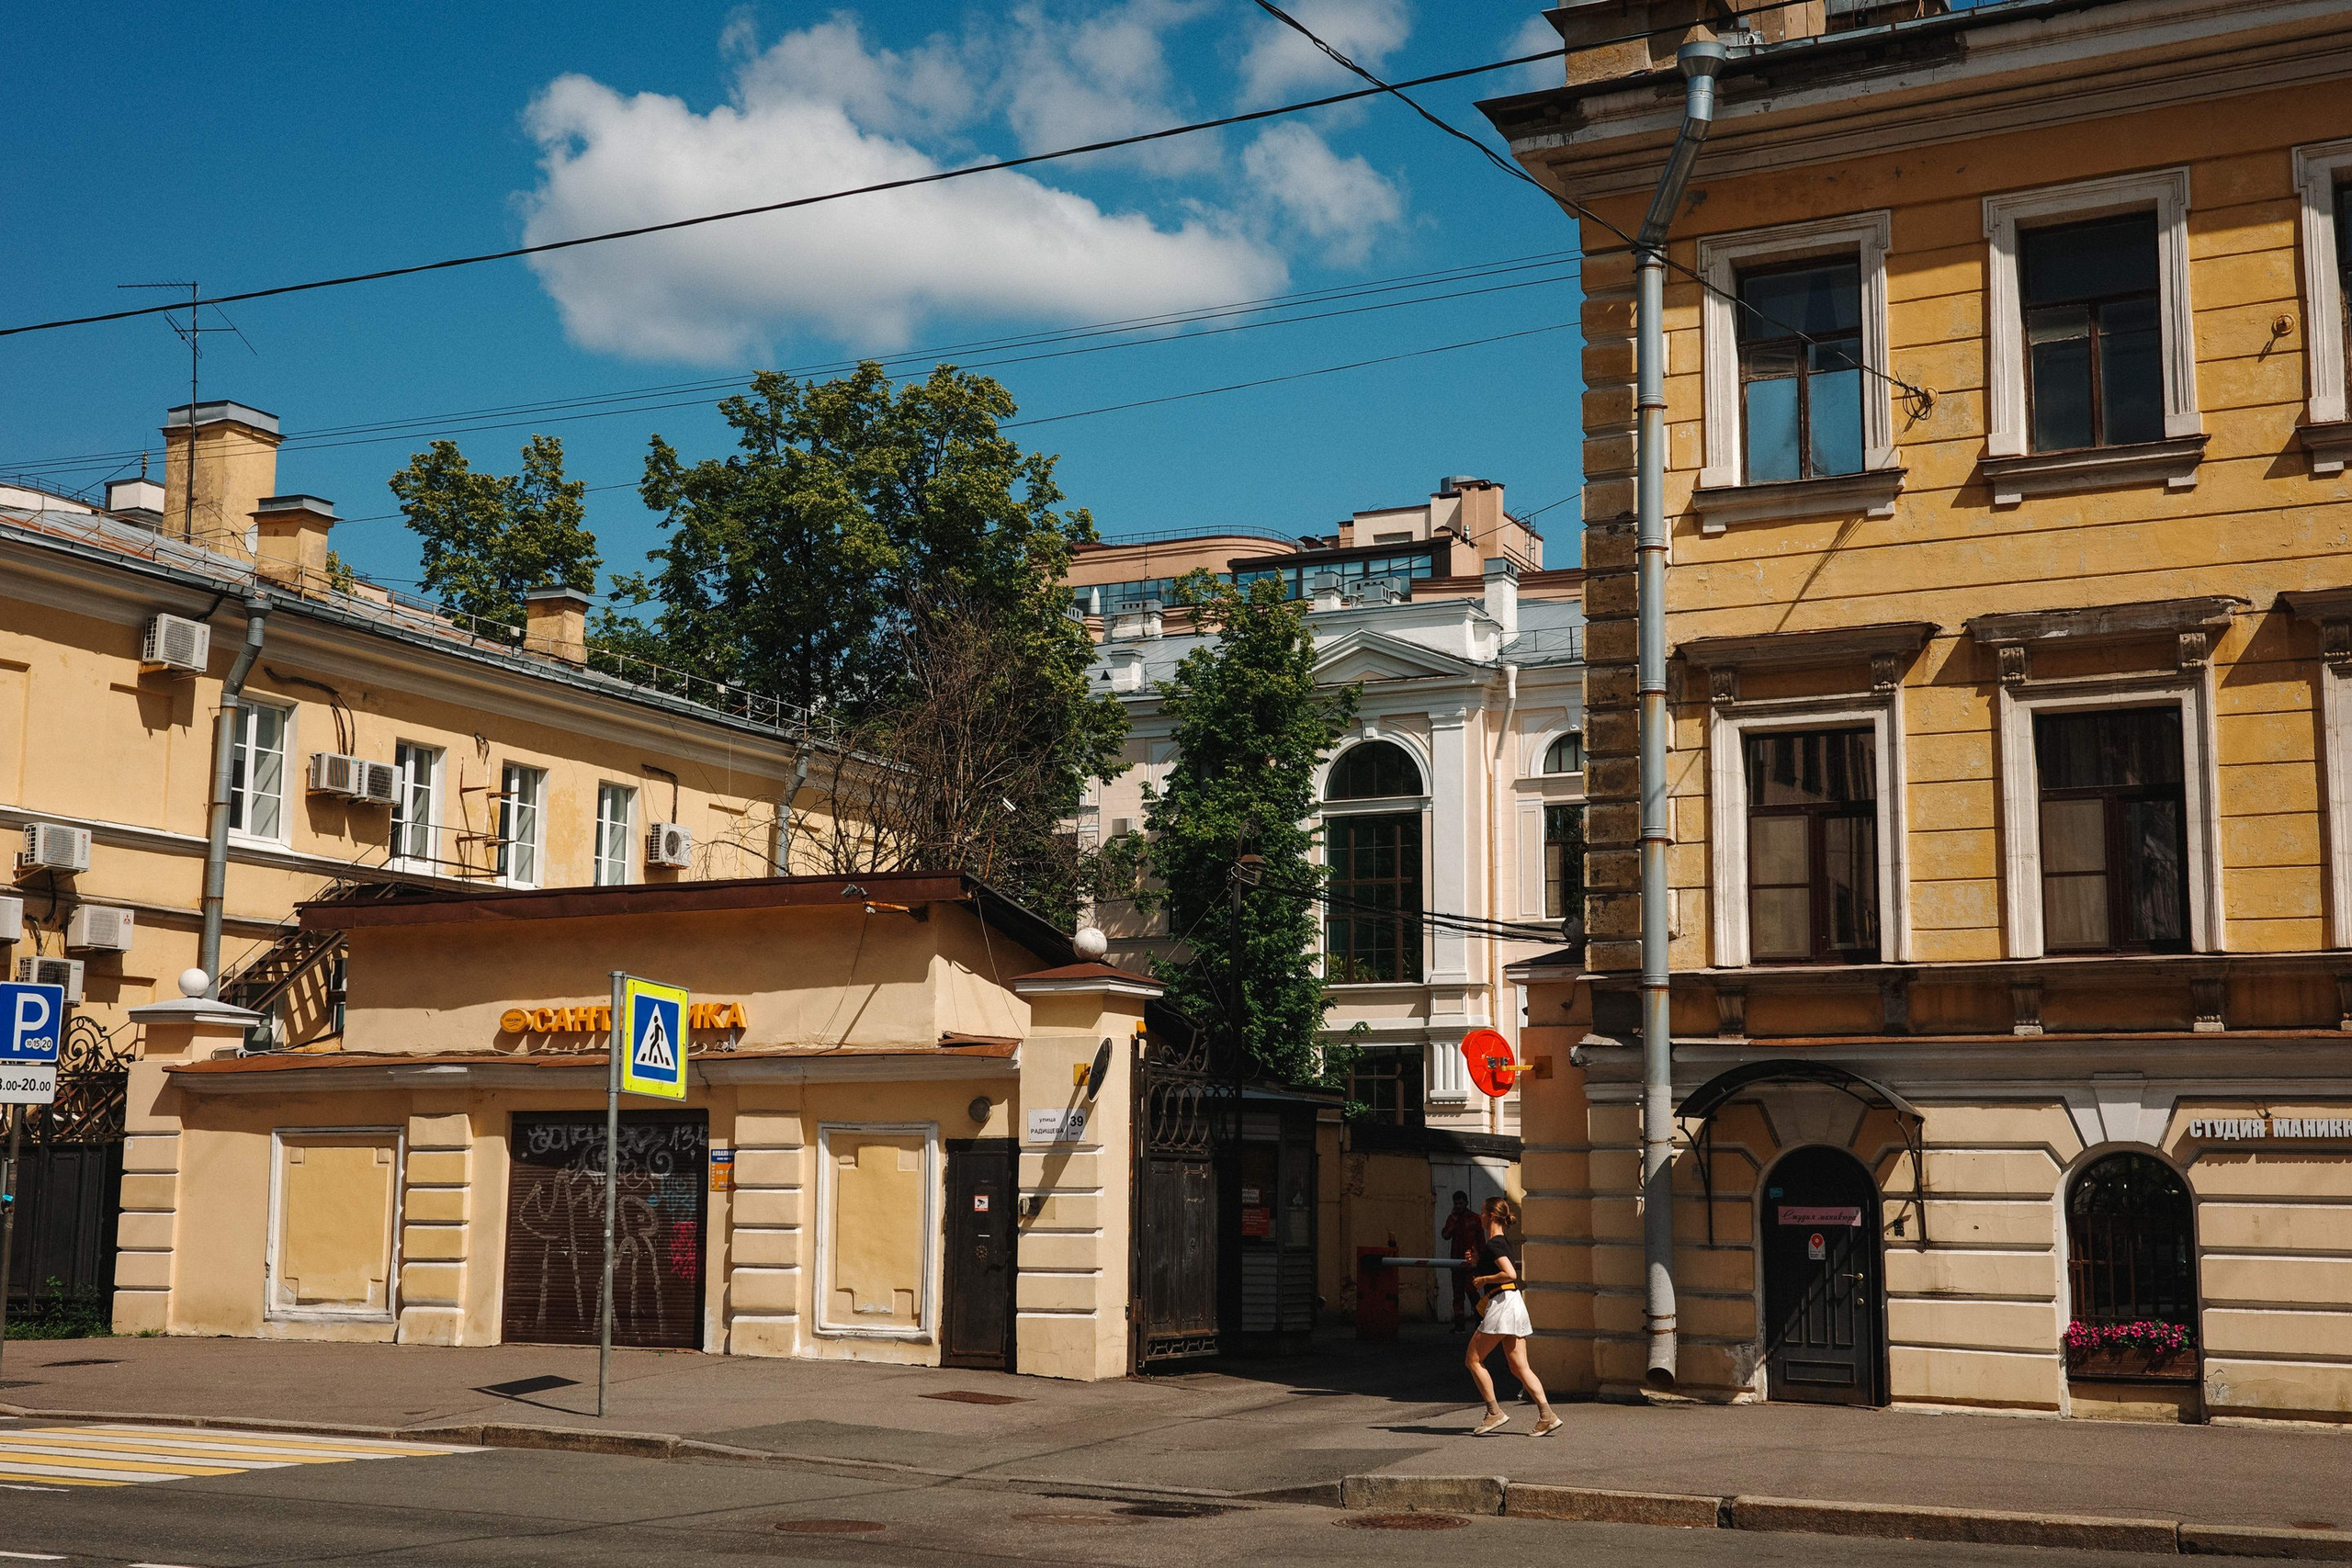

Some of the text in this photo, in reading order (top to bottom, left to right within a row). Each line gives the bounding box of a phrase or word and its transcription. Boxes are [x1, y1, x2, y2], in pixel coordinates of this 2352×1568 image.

[13, 993, 50, 1051] P
[533, 1001, 748, 1033] САНТИКА
[41, 1039, 52, 1049] 20
[1069, 1115, 1084, 1127] 39
[2189, 1118, 2266, 1141] СТУДИЯ
[1782, 1209, 1857, 1223] Студия маникюра
